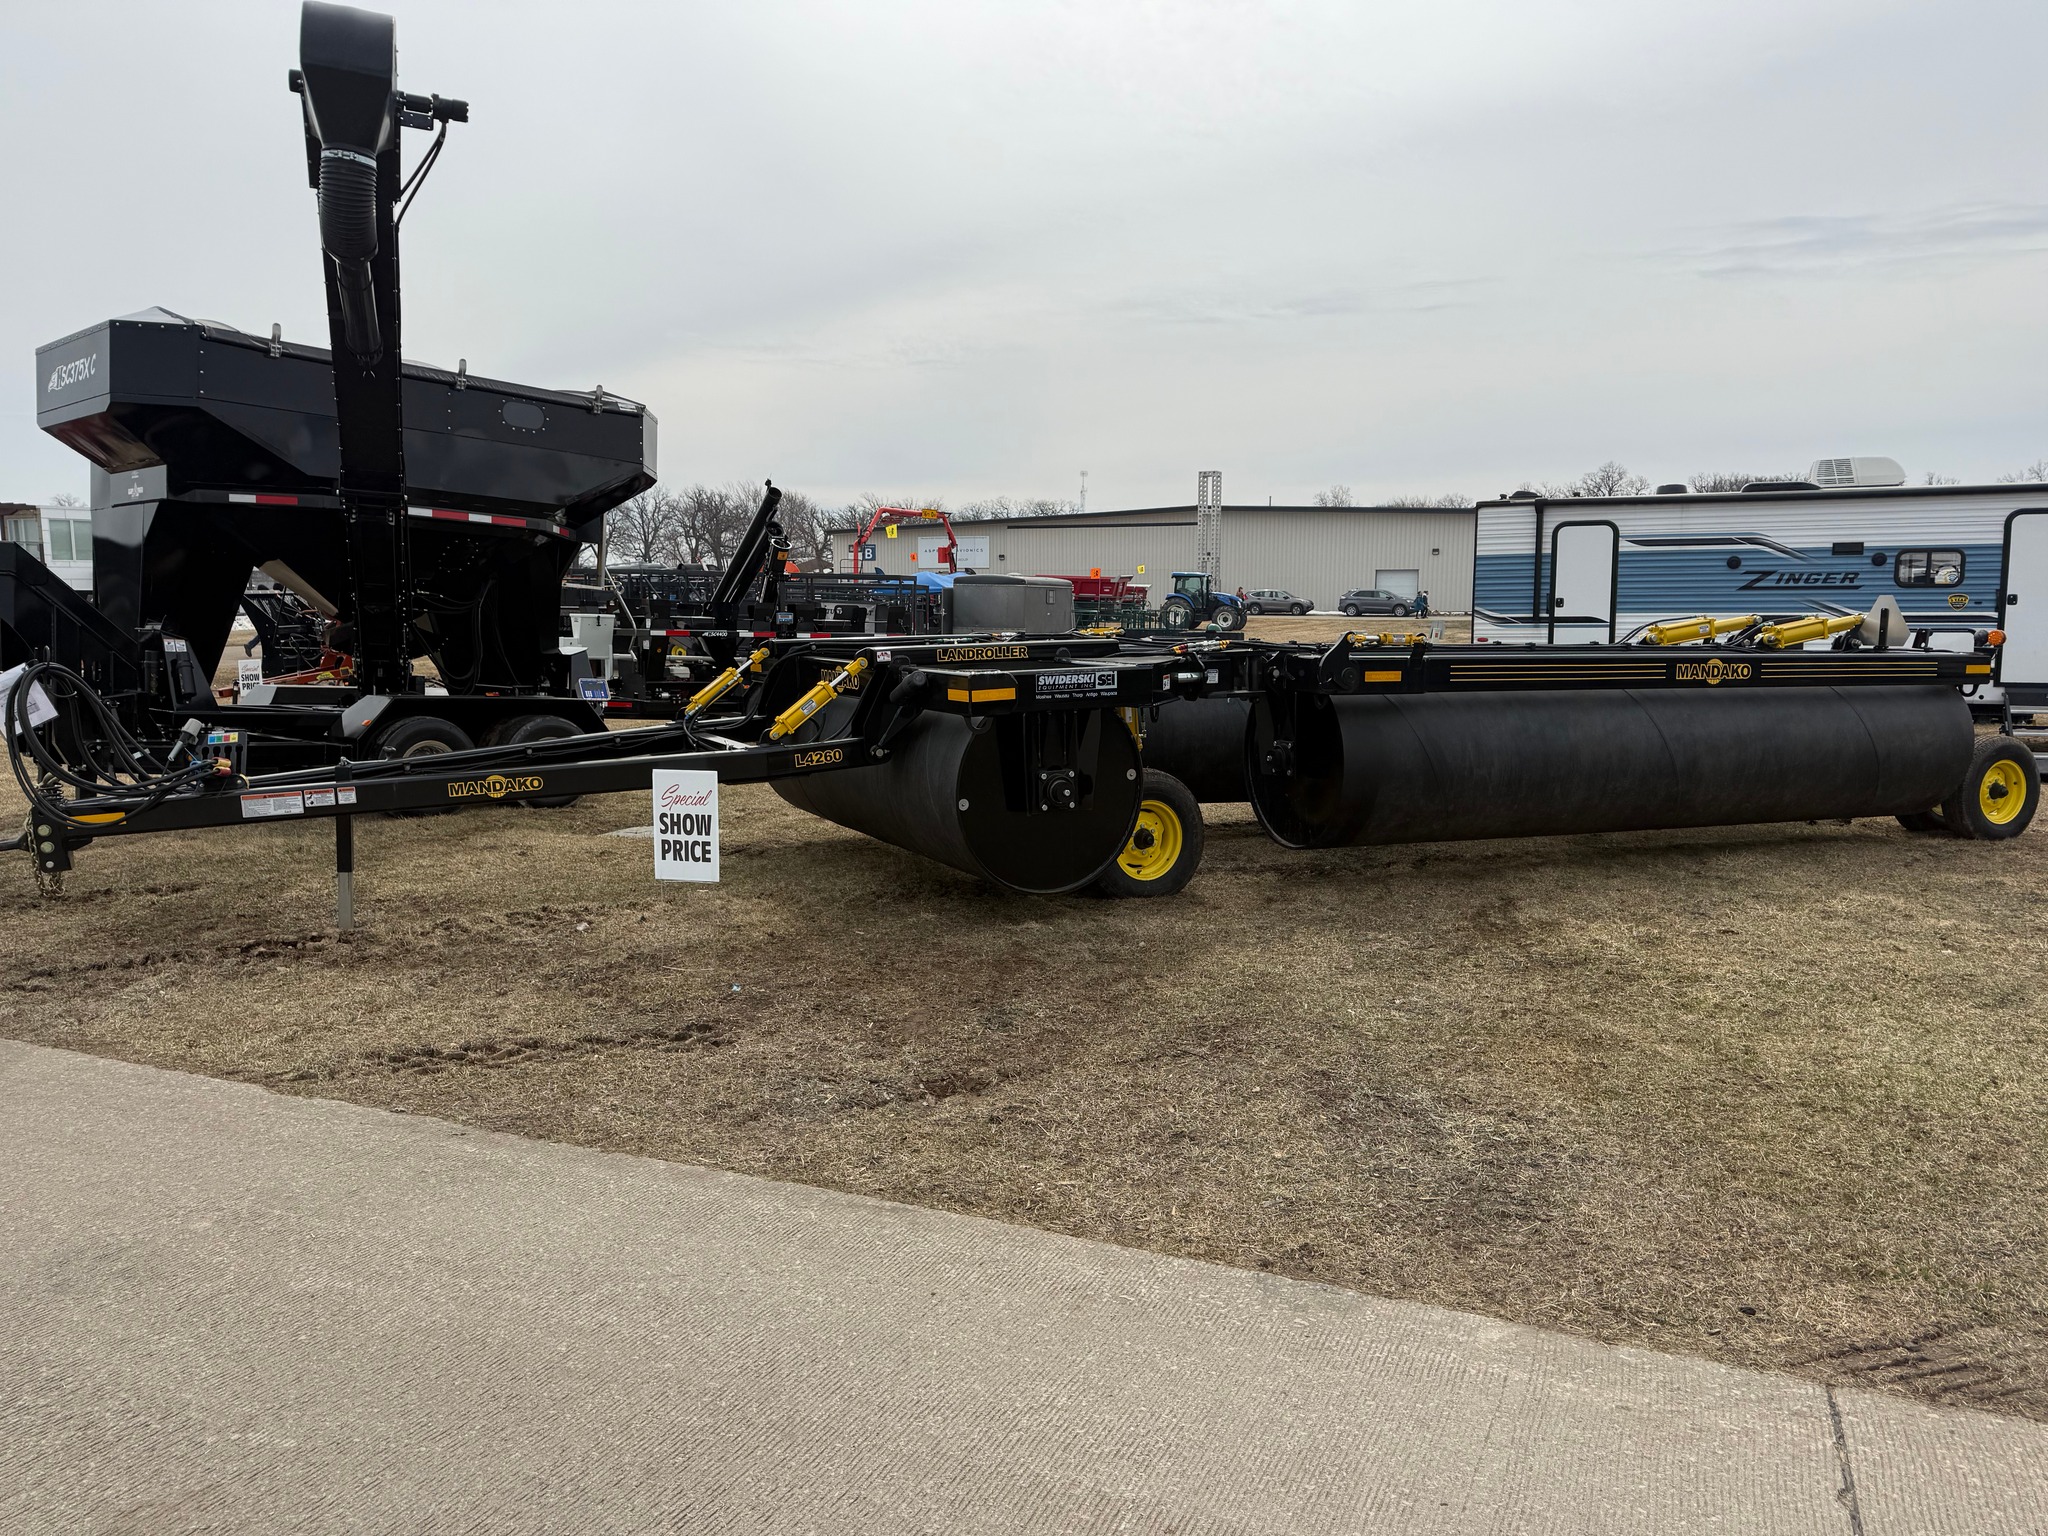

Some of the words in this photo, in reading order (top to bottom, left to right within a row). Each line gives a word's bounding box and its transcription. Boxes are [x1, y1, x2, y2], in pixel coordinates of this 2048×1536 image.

[865, 548, 873, 559] B
[1736, 570, 1861, 590] ZINGER
[937, 646, 1028, 662] LANDROLLER
[241, 673, 260, 682] SHOW
[1038, 673, 1095, 686] SWIDERSKI
[1676, 663, 1752, 680] MANDAKO
[242, 682, 260, 690] PRI
[794, 748, 843, 768] L4260
[447, 776, 544, 798] MANDAKO
[661, 783, 713, 812] Special
[659, 812, 712, 837] SHOW
[661, 839, 712, 863] PRICE
